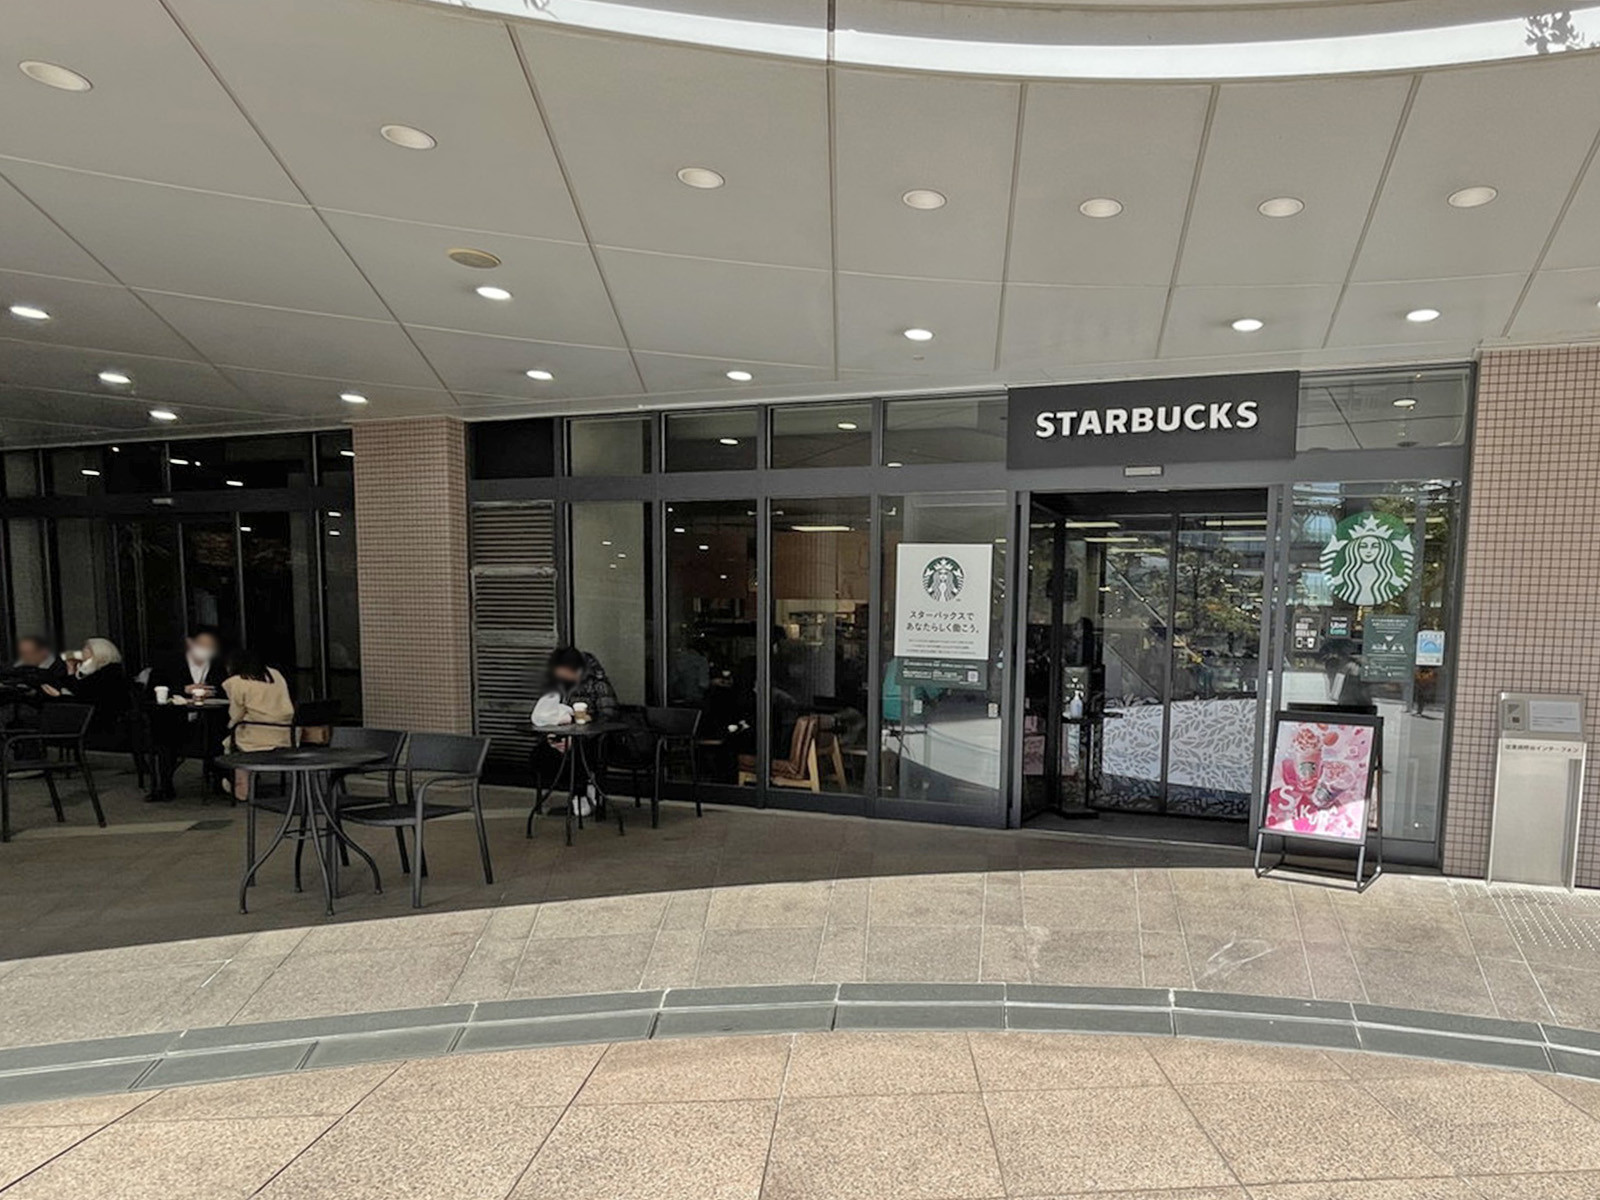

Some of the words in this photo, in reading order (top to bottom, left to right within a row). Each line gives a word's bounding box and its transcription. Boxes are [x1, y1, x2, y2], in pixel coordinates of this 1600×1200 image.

[1036, 401, 1258, 438] STARBUCKS
[909, 610, 975, 621] スターバックスで
